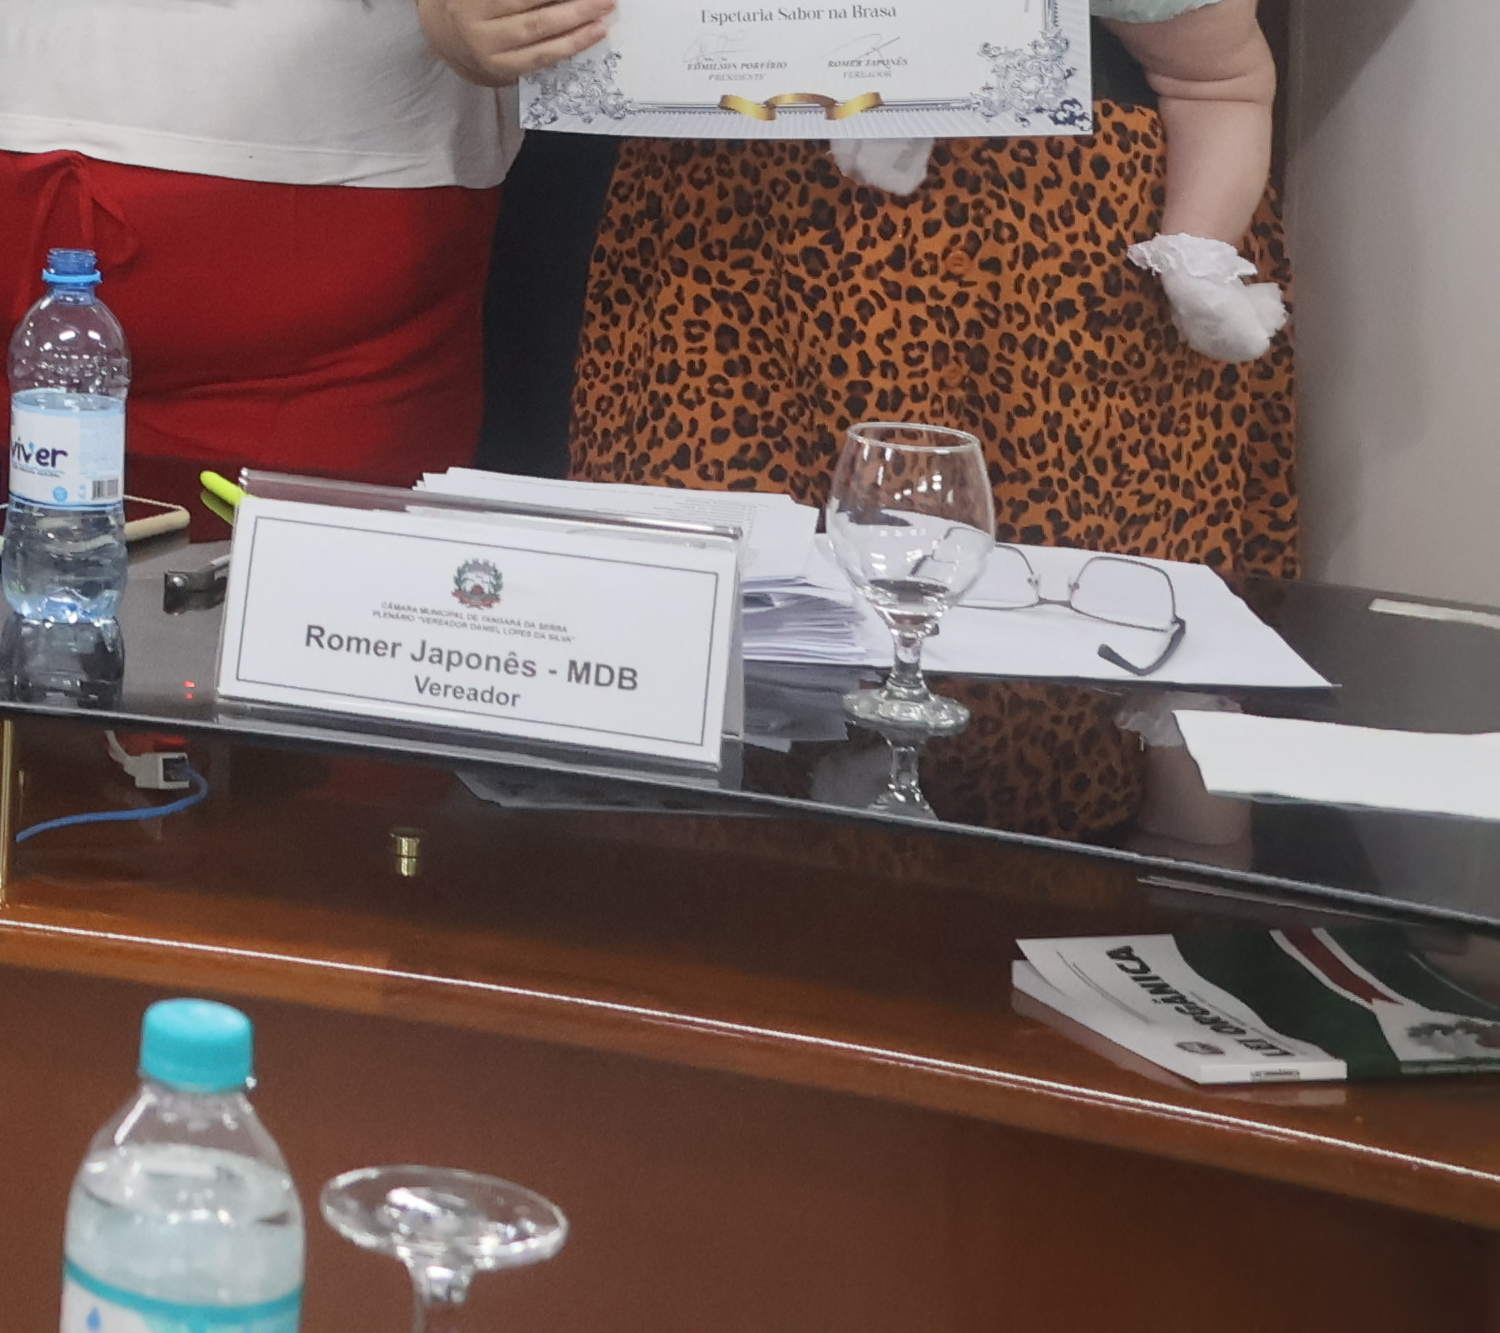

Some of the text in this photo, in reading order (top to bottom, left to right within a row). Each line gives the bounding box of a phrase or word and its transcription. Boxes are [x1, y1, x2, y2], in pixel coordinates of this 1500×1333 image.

[778, 6, 825, 21] Sabor
[828, 9, 847, 21] na
[852, 4, 897, 19] Brasa
[305, 624, 403, 659] Romer
[410, 639, 537, 678] Japonês
[567, 659, 638, 691] MDB
[414, 674, 521, 708] Vereador
